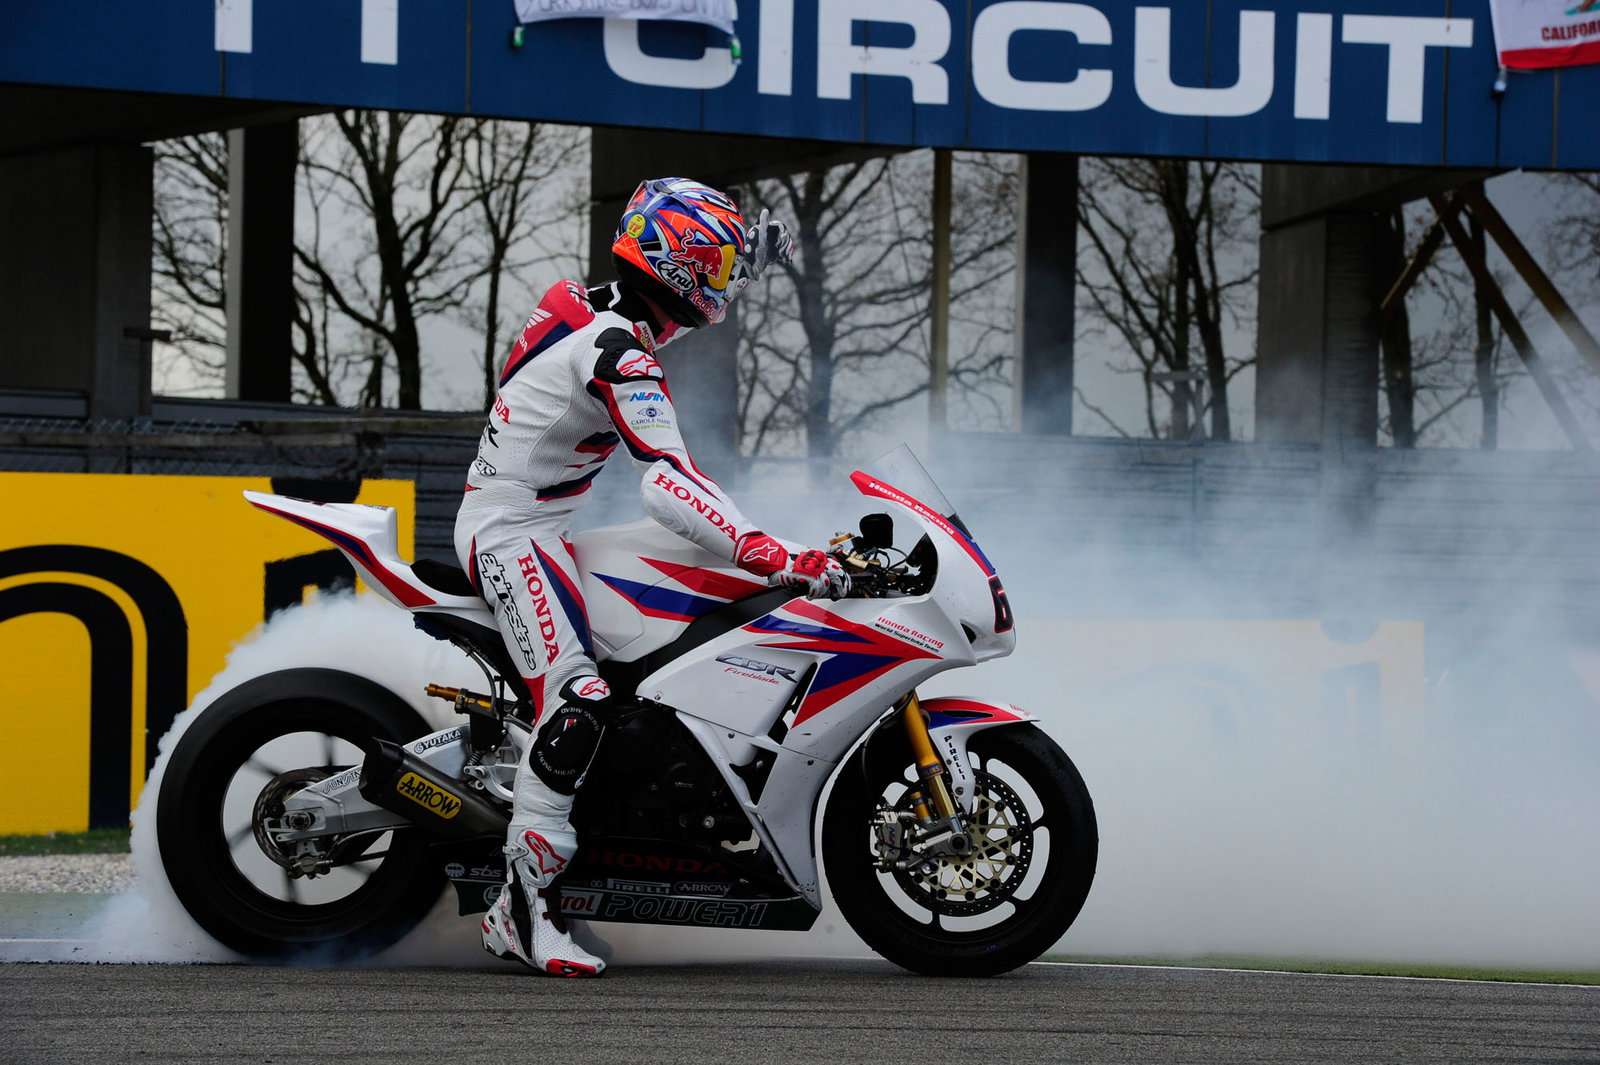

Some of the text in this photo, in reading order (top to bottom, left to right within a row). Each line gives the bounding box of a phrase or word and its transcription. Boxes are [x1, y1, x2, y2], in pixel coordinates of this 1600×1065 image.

[1541, 19, 1600, 42] CALIFOR
[603, 0, 1473, 124] CIRCUIT
[661, 264, 693, 289] Arai
[629, 391, 666, 402] NISSIN
[652, 473, 738, 543] HONDA
[869, 481, 955, 535] Honda Racing
[517, 553, 560, 667] HONDA
[874, 622, 941, 653] World Superbike Team
[877, 616, 945, 649] Honda Racing
[715, 653, 799, 684] CBR
[723, 667, 780, 686] Fireblade
[424, 729, 462, 750] YUTAKA
[944, 734, 967, 781] PIRELLI
[400, 776, 460, 816] ARROW
[469, 864, 502, 878] sbs
[607, 877, 671, 895] PIRELLI
[680, 882, 729, 894] ARROW
[605, 896, 769, 928] POWER1
